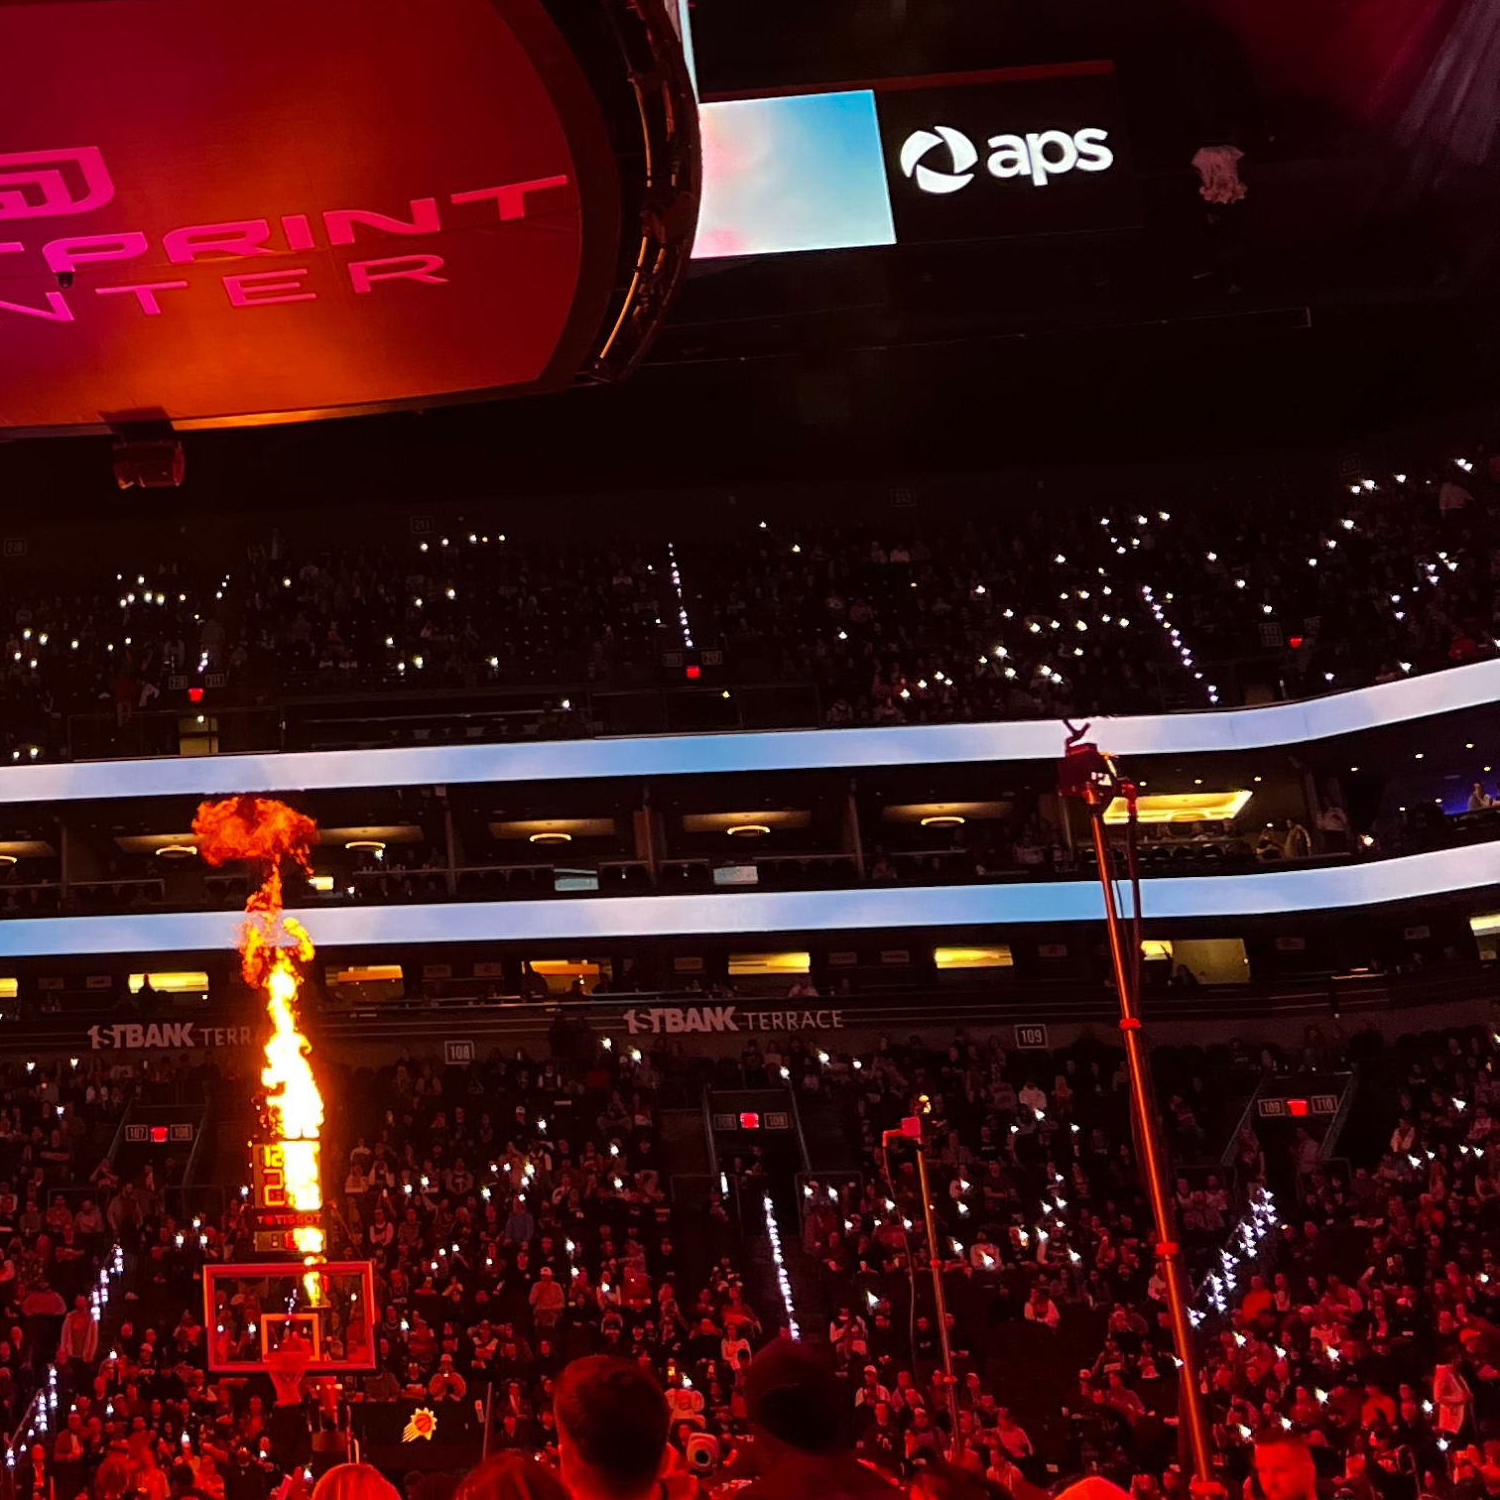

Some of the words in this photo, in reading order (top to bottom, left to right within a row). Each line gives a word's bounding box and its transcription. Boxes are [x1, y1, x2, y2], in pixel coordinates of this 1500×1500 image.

[987, 127, 1113, 186] aps
[622, 1006, 740, 1035] 1STBANK
[743, 1010, 845, 1032] TERRACE
[87, 1022, 195, 1050] 1STBANK
[200, 1026, 251, 1047] TERR
[1020, 1029, 1043, 1044] 109
